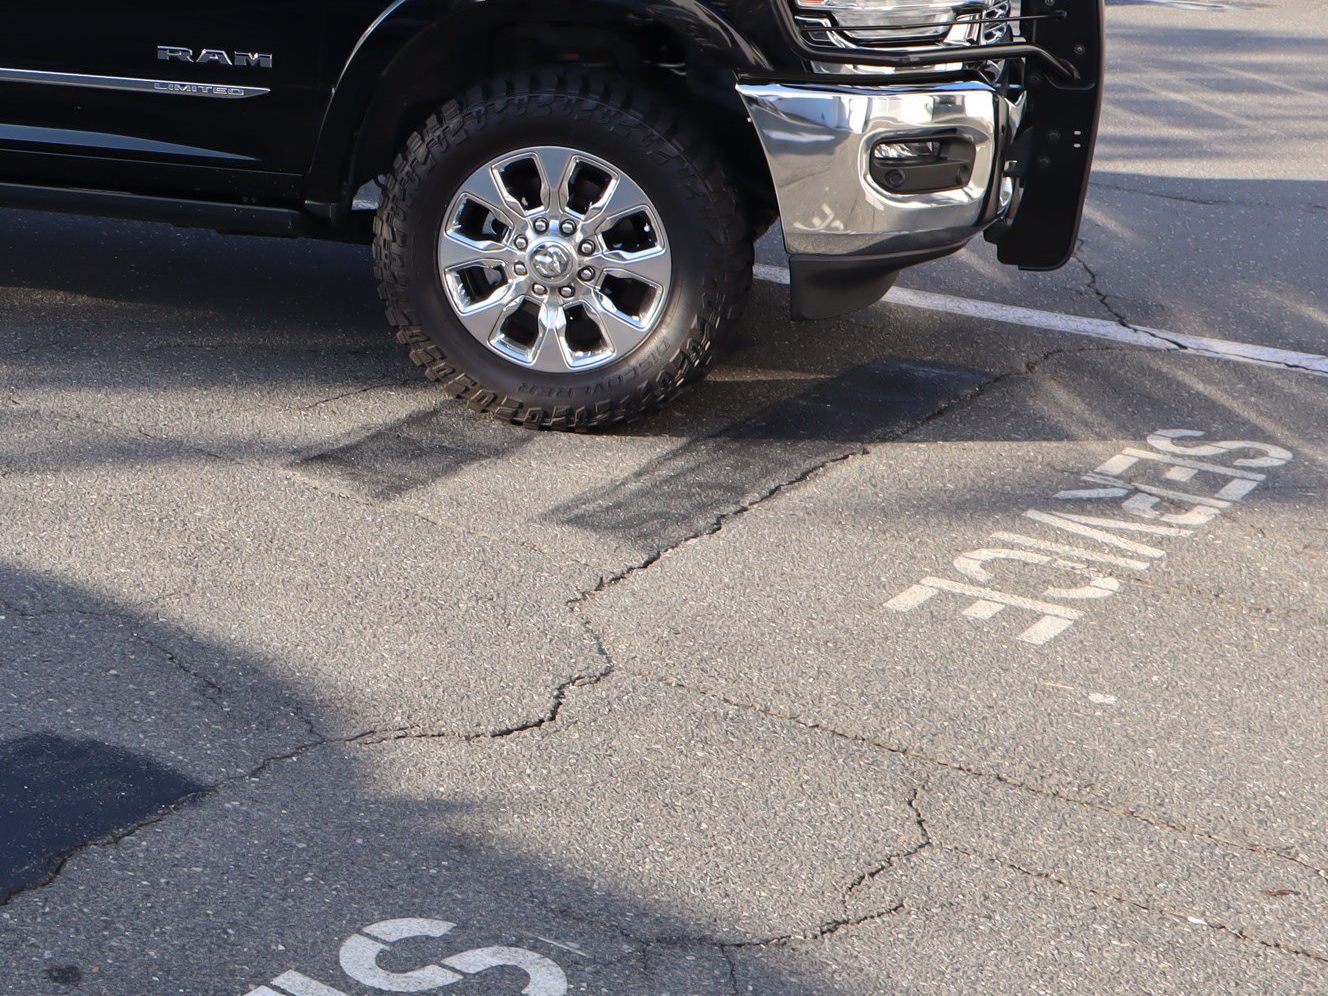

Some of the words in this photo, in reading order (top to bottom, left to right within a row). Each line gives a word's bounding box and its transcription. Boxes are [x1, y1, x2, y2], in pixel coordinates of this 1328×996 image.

[157, 45, 272, 68] RAM
[154, 82, 244, 96] LIMITED
[882, 428, 1293, 646] SERVICE
